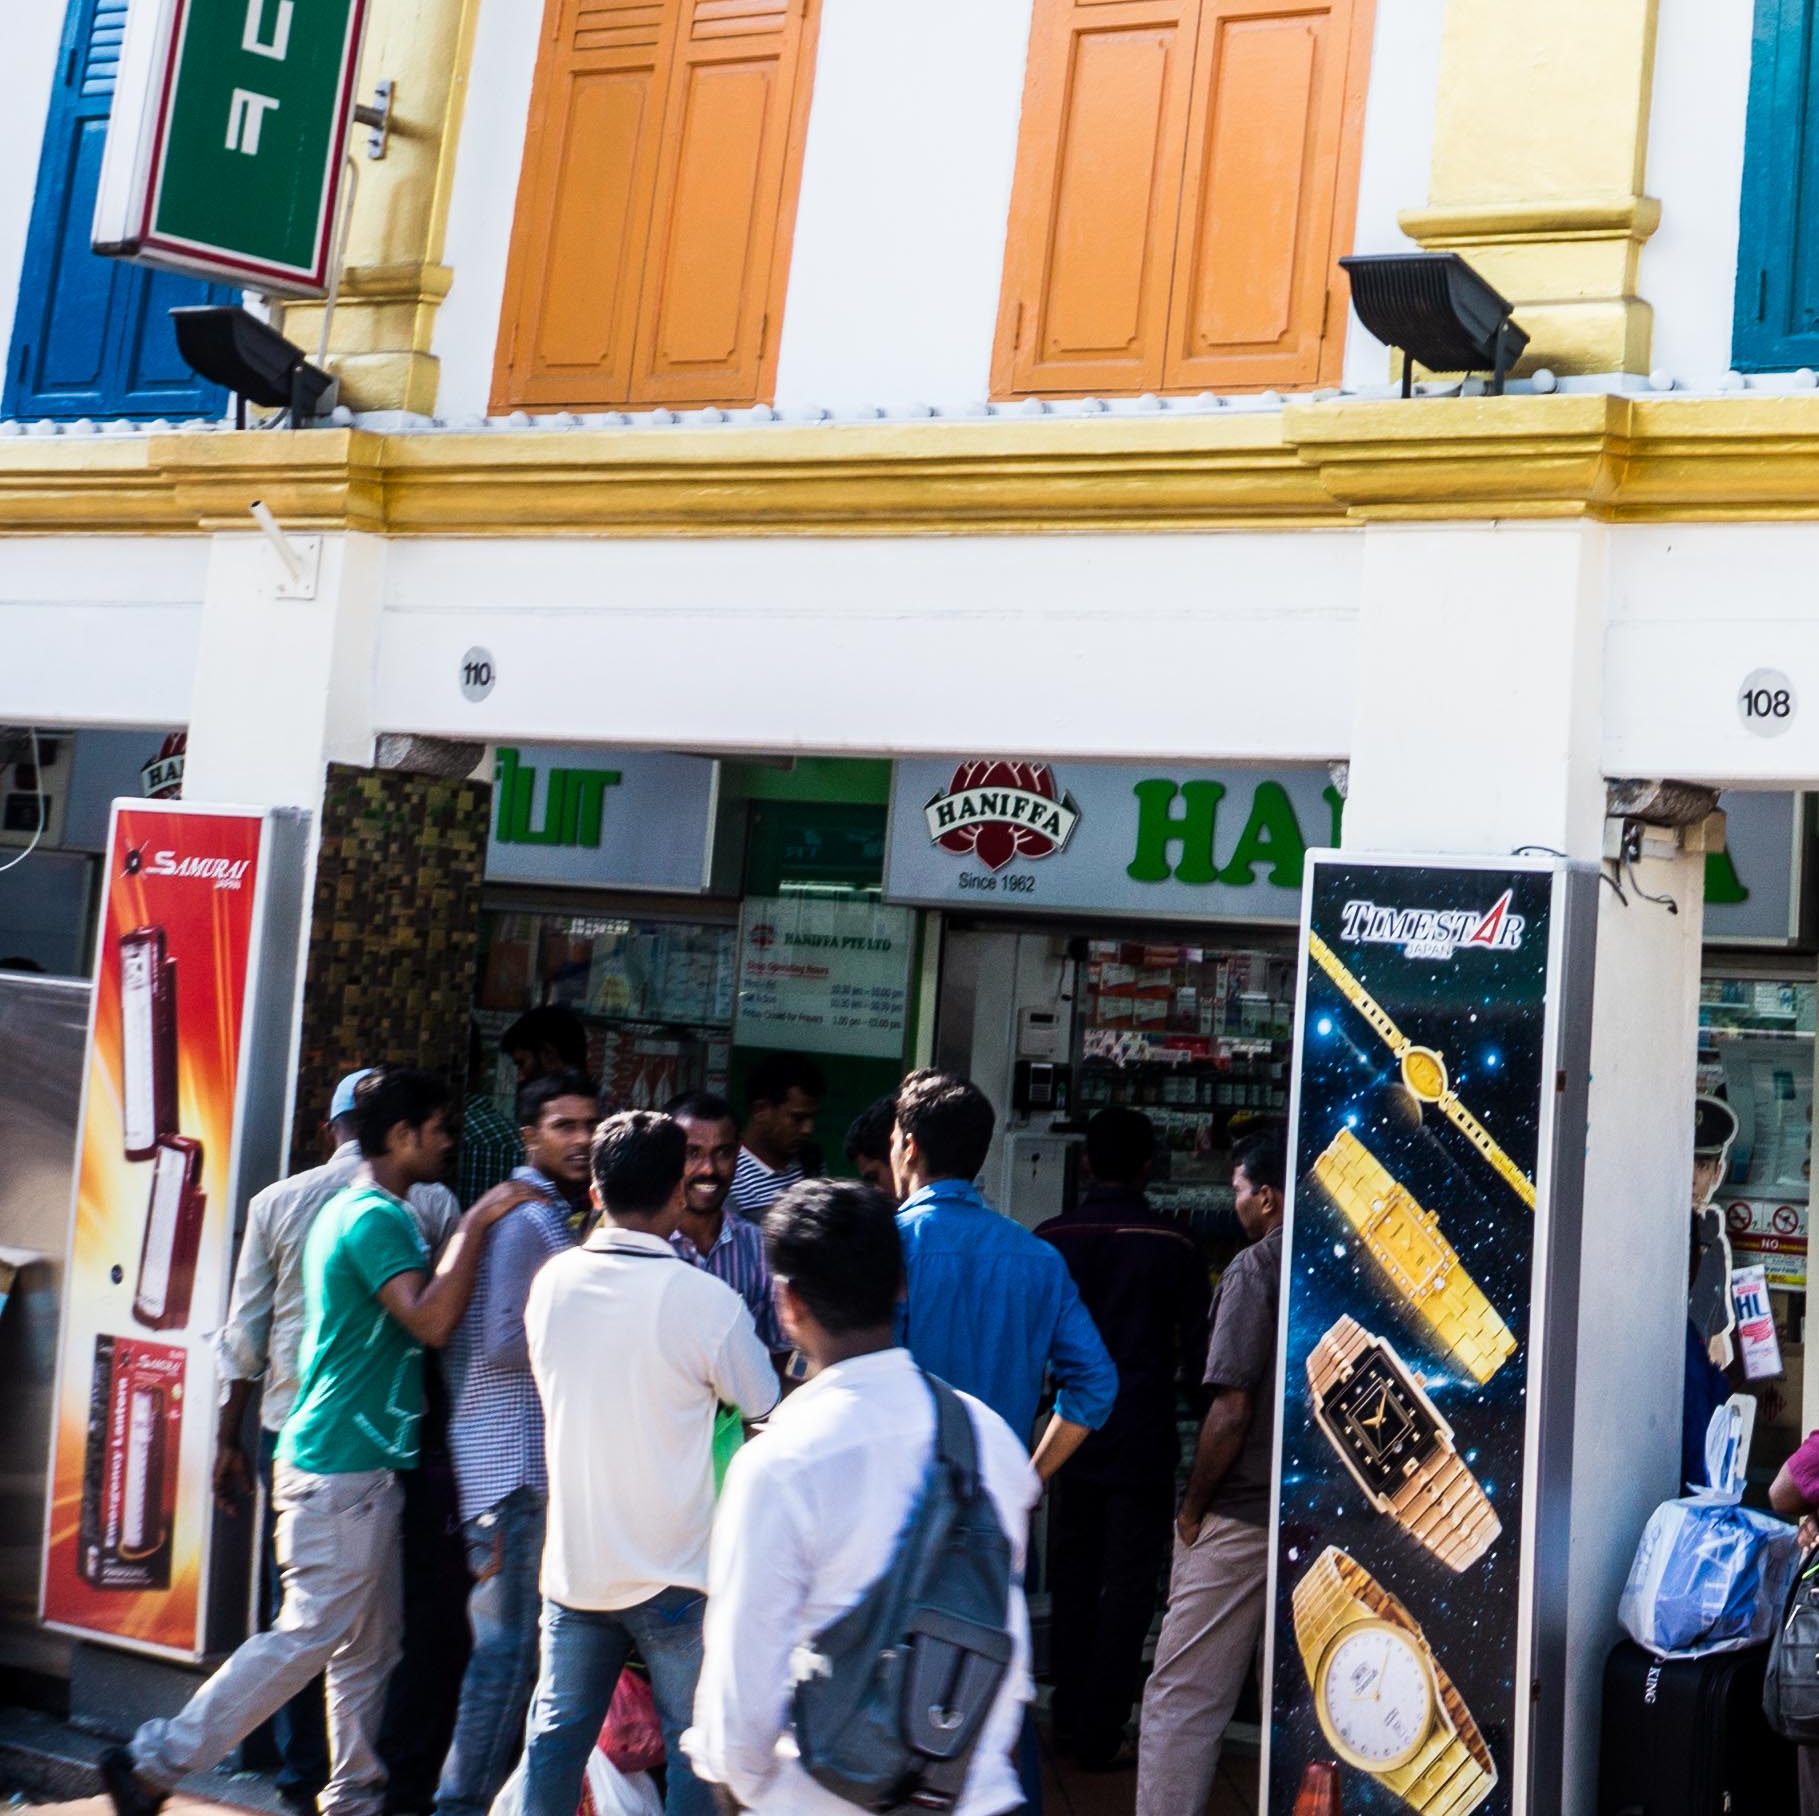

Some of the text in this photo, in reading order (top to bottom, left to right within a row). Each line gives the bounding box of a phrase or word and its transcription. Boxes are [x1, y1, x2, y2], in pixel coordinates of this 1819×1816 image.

[463, 662, 492, 686] 110
[1742, 686, 1791, 718] 108
[936, 791, 1061, 838] HANIFFA
[1126, 778, 1342, 888] HA
[146, 851, 251, 880] SAMURAI
[958, 871, 1036, 893] Since 1962
[1341, 888, 1526, 951] TIMESTAR
